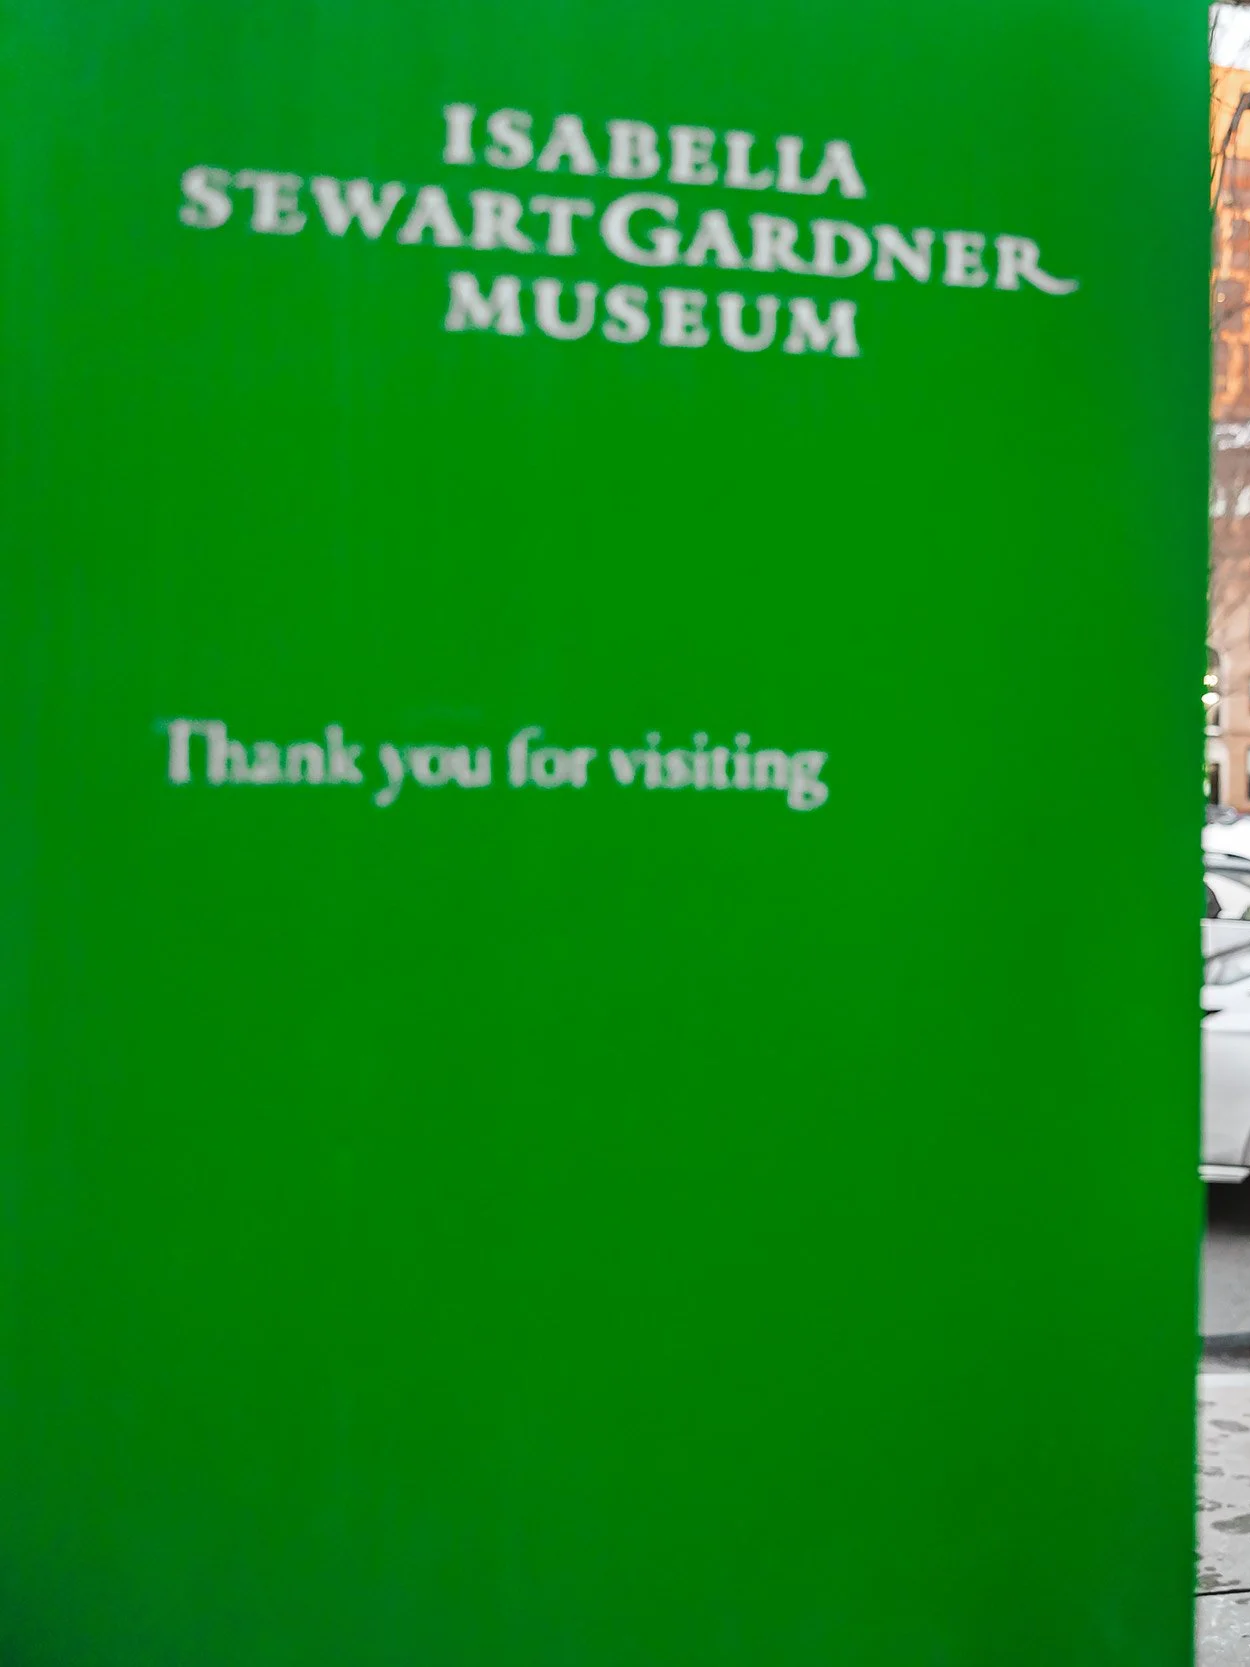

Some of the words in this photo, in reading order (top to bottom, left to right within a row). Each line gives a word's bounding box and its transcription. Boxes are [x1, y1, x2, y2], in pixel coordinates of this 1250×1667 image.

[441, 103, 866, 199] ISABELLA
[179, 165, 595, 254] STEWART
[599, 193, 1077, 297] GARDNER
[445, 272, 860, 358] MUSEUM
[167, 718, 365, 785] Thank
[375, 742, 492, 810] you
[507, 728, 598, 788] for
[609, 733, 830, 812] visiting
